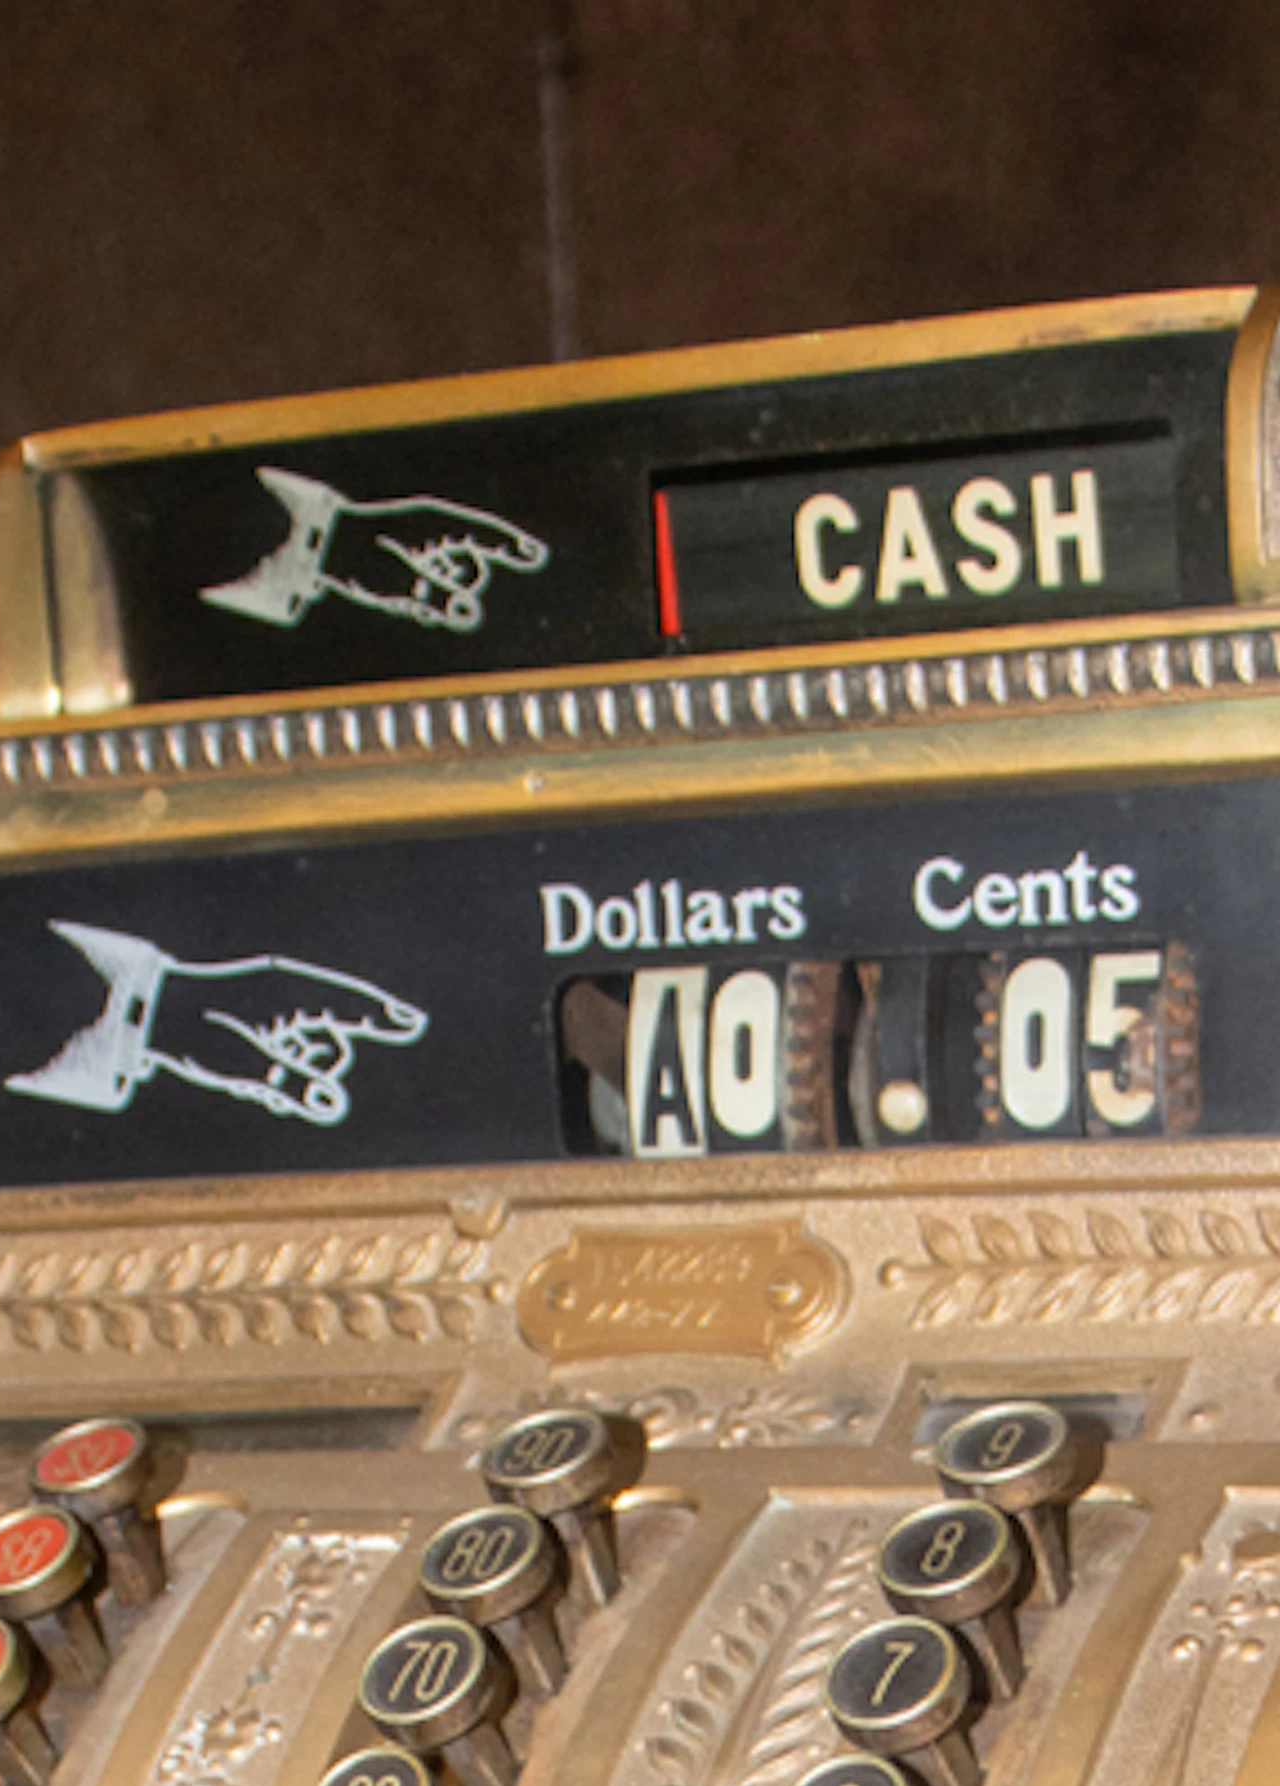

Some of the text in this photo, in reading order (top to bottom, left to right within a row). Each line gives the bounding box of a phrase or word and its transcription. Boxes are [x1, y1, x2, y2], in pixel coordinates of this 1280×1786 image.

[794, 469, 1104, 609] CASH
[540, 850, 1139, 954] Dollars Cents
[506, 1428, 574, 1471] 90
[982, 1423, 1024, 1468] 9
[442, 1525, 515, 1581] 80
[921, 1521, 964, 1576] 8
[388, 1640, 459, 1701] 70
[871, 1641, 916, 1706] 7
